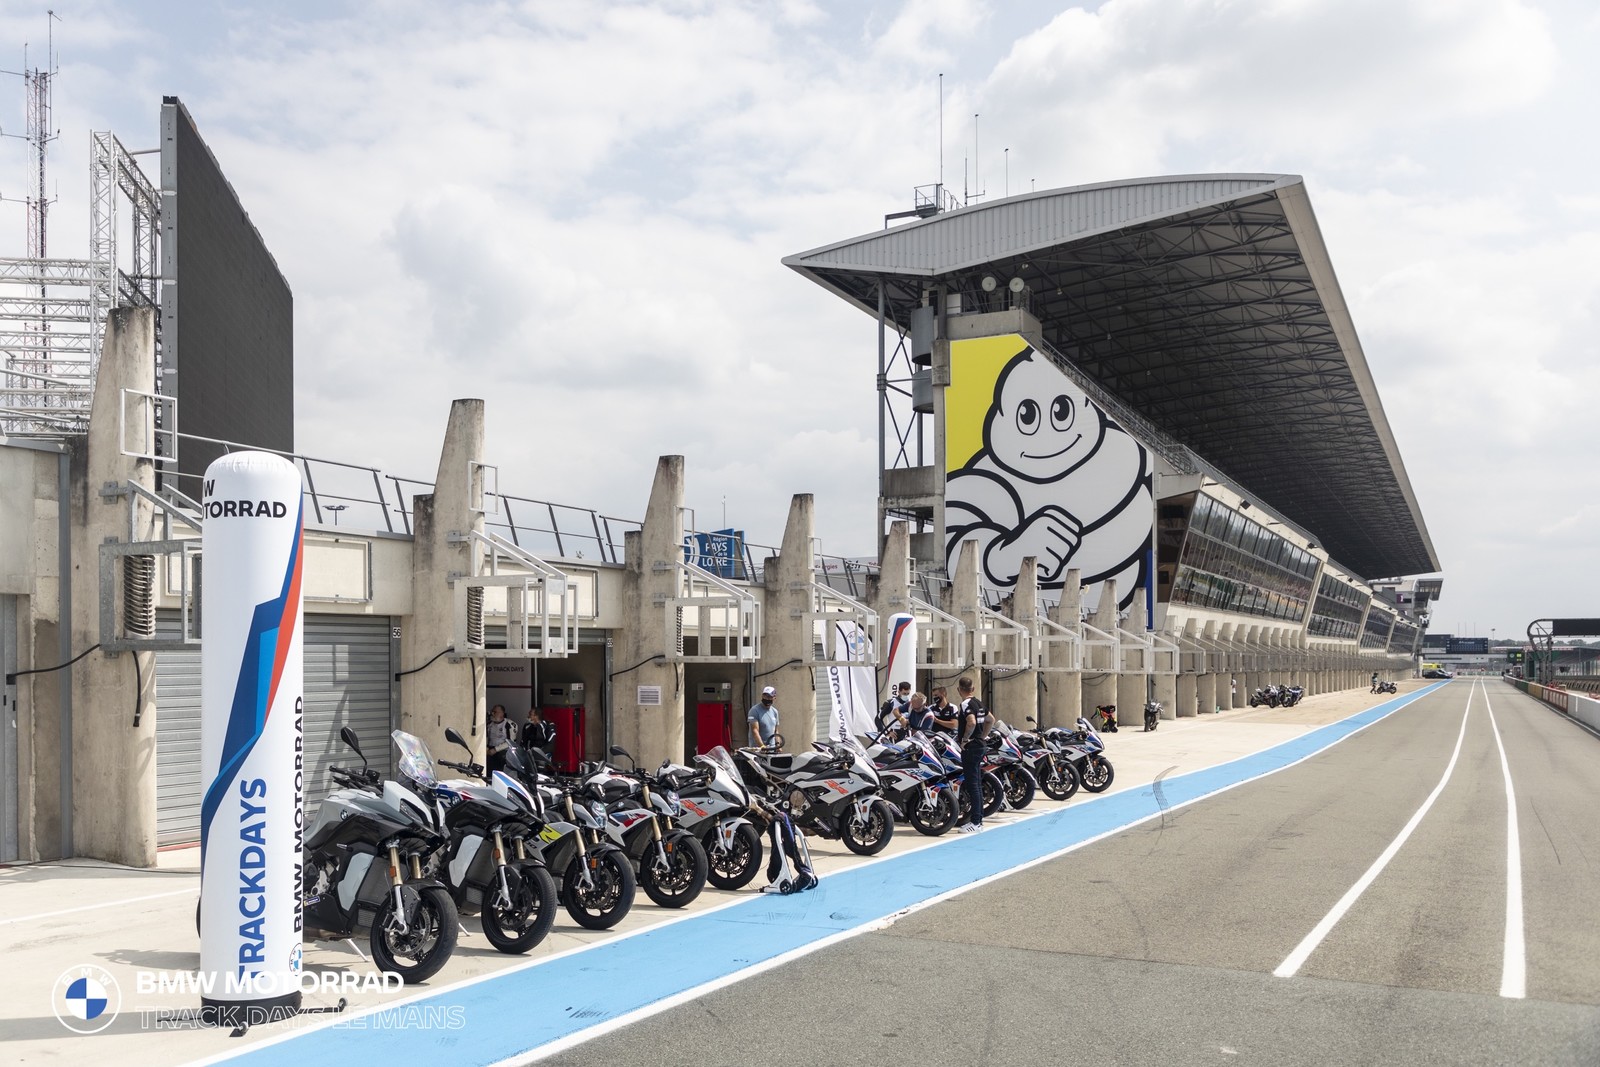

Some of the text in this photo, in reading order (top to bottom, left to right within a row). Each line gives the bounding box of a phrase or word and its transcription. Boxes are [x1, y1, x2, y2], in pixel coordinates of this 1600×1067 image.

[204, 500, 287, 519] TORRAD
[702, 557, 728, 567] LORE
[293, 696, 303, 933] BMW MOTORRAD
